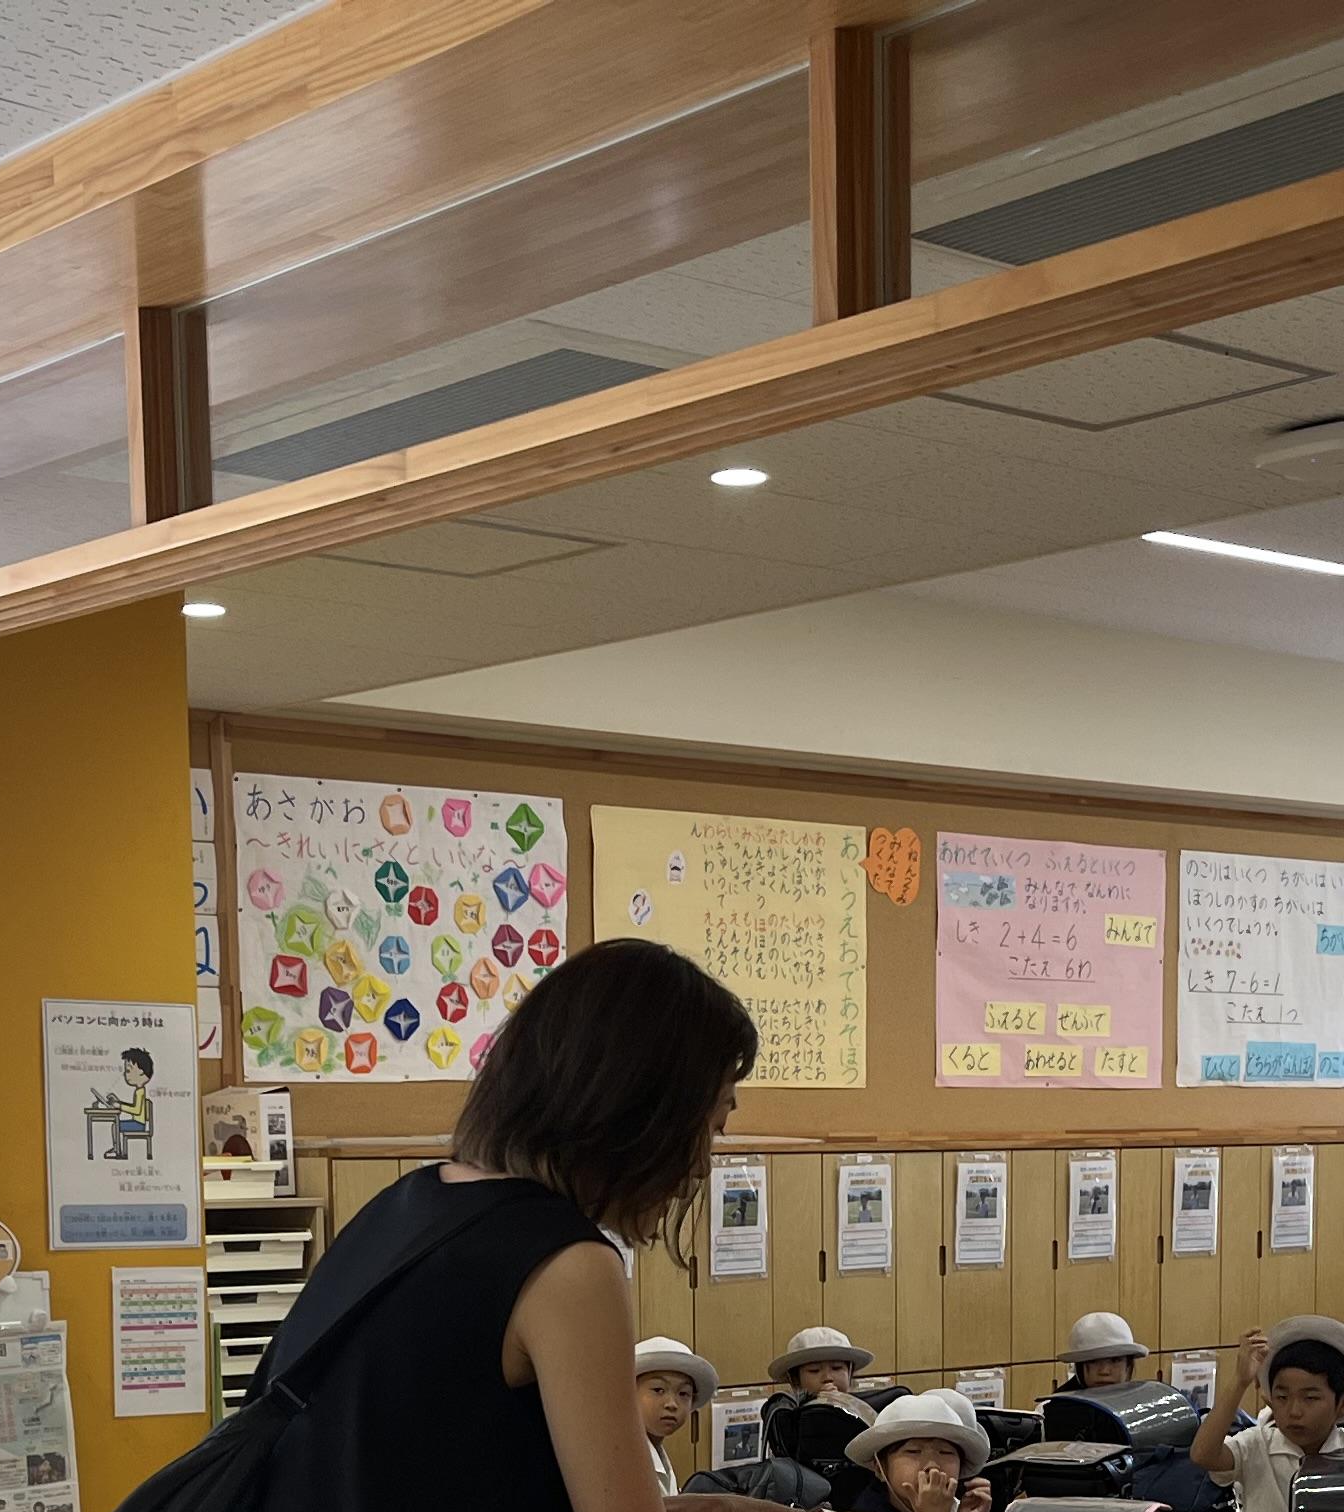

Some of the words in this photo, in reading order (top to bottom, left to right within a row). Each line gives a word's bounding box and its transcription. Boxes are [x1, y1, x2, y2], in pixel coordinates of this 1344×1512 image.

[245, 783, 366, 825] あさがお
[938, 841, 1031, 870] あわせていくつ
[1185, 859, 1268, 884] のこりはいくつ
[955, 919, 982, 946] しき
[1105, 916, 1156, 942] みんなで
[1008, 955, 1050, 976] こたえ
[1188, 968, 1215, 993] しき
[51, 1014, 165, 1028] パソコンに向かう時は
[985, 1003, 1038, 1031] ふえると
[1226, 1001, 1266, 1023] こたえ
[769, 999, 781, 1081] なにぬねの
[780, 998, 792, 1081] たちつてと
[791, 998, 803, 1081] さしすせそ
[803, 999, 815, 1081] かきくけこ
[814, 998, 828, 1083] あいうえお
[1024, 1048, 1078, 1071] あわせると
[1100, 1051, 1139, 1073] たすと
